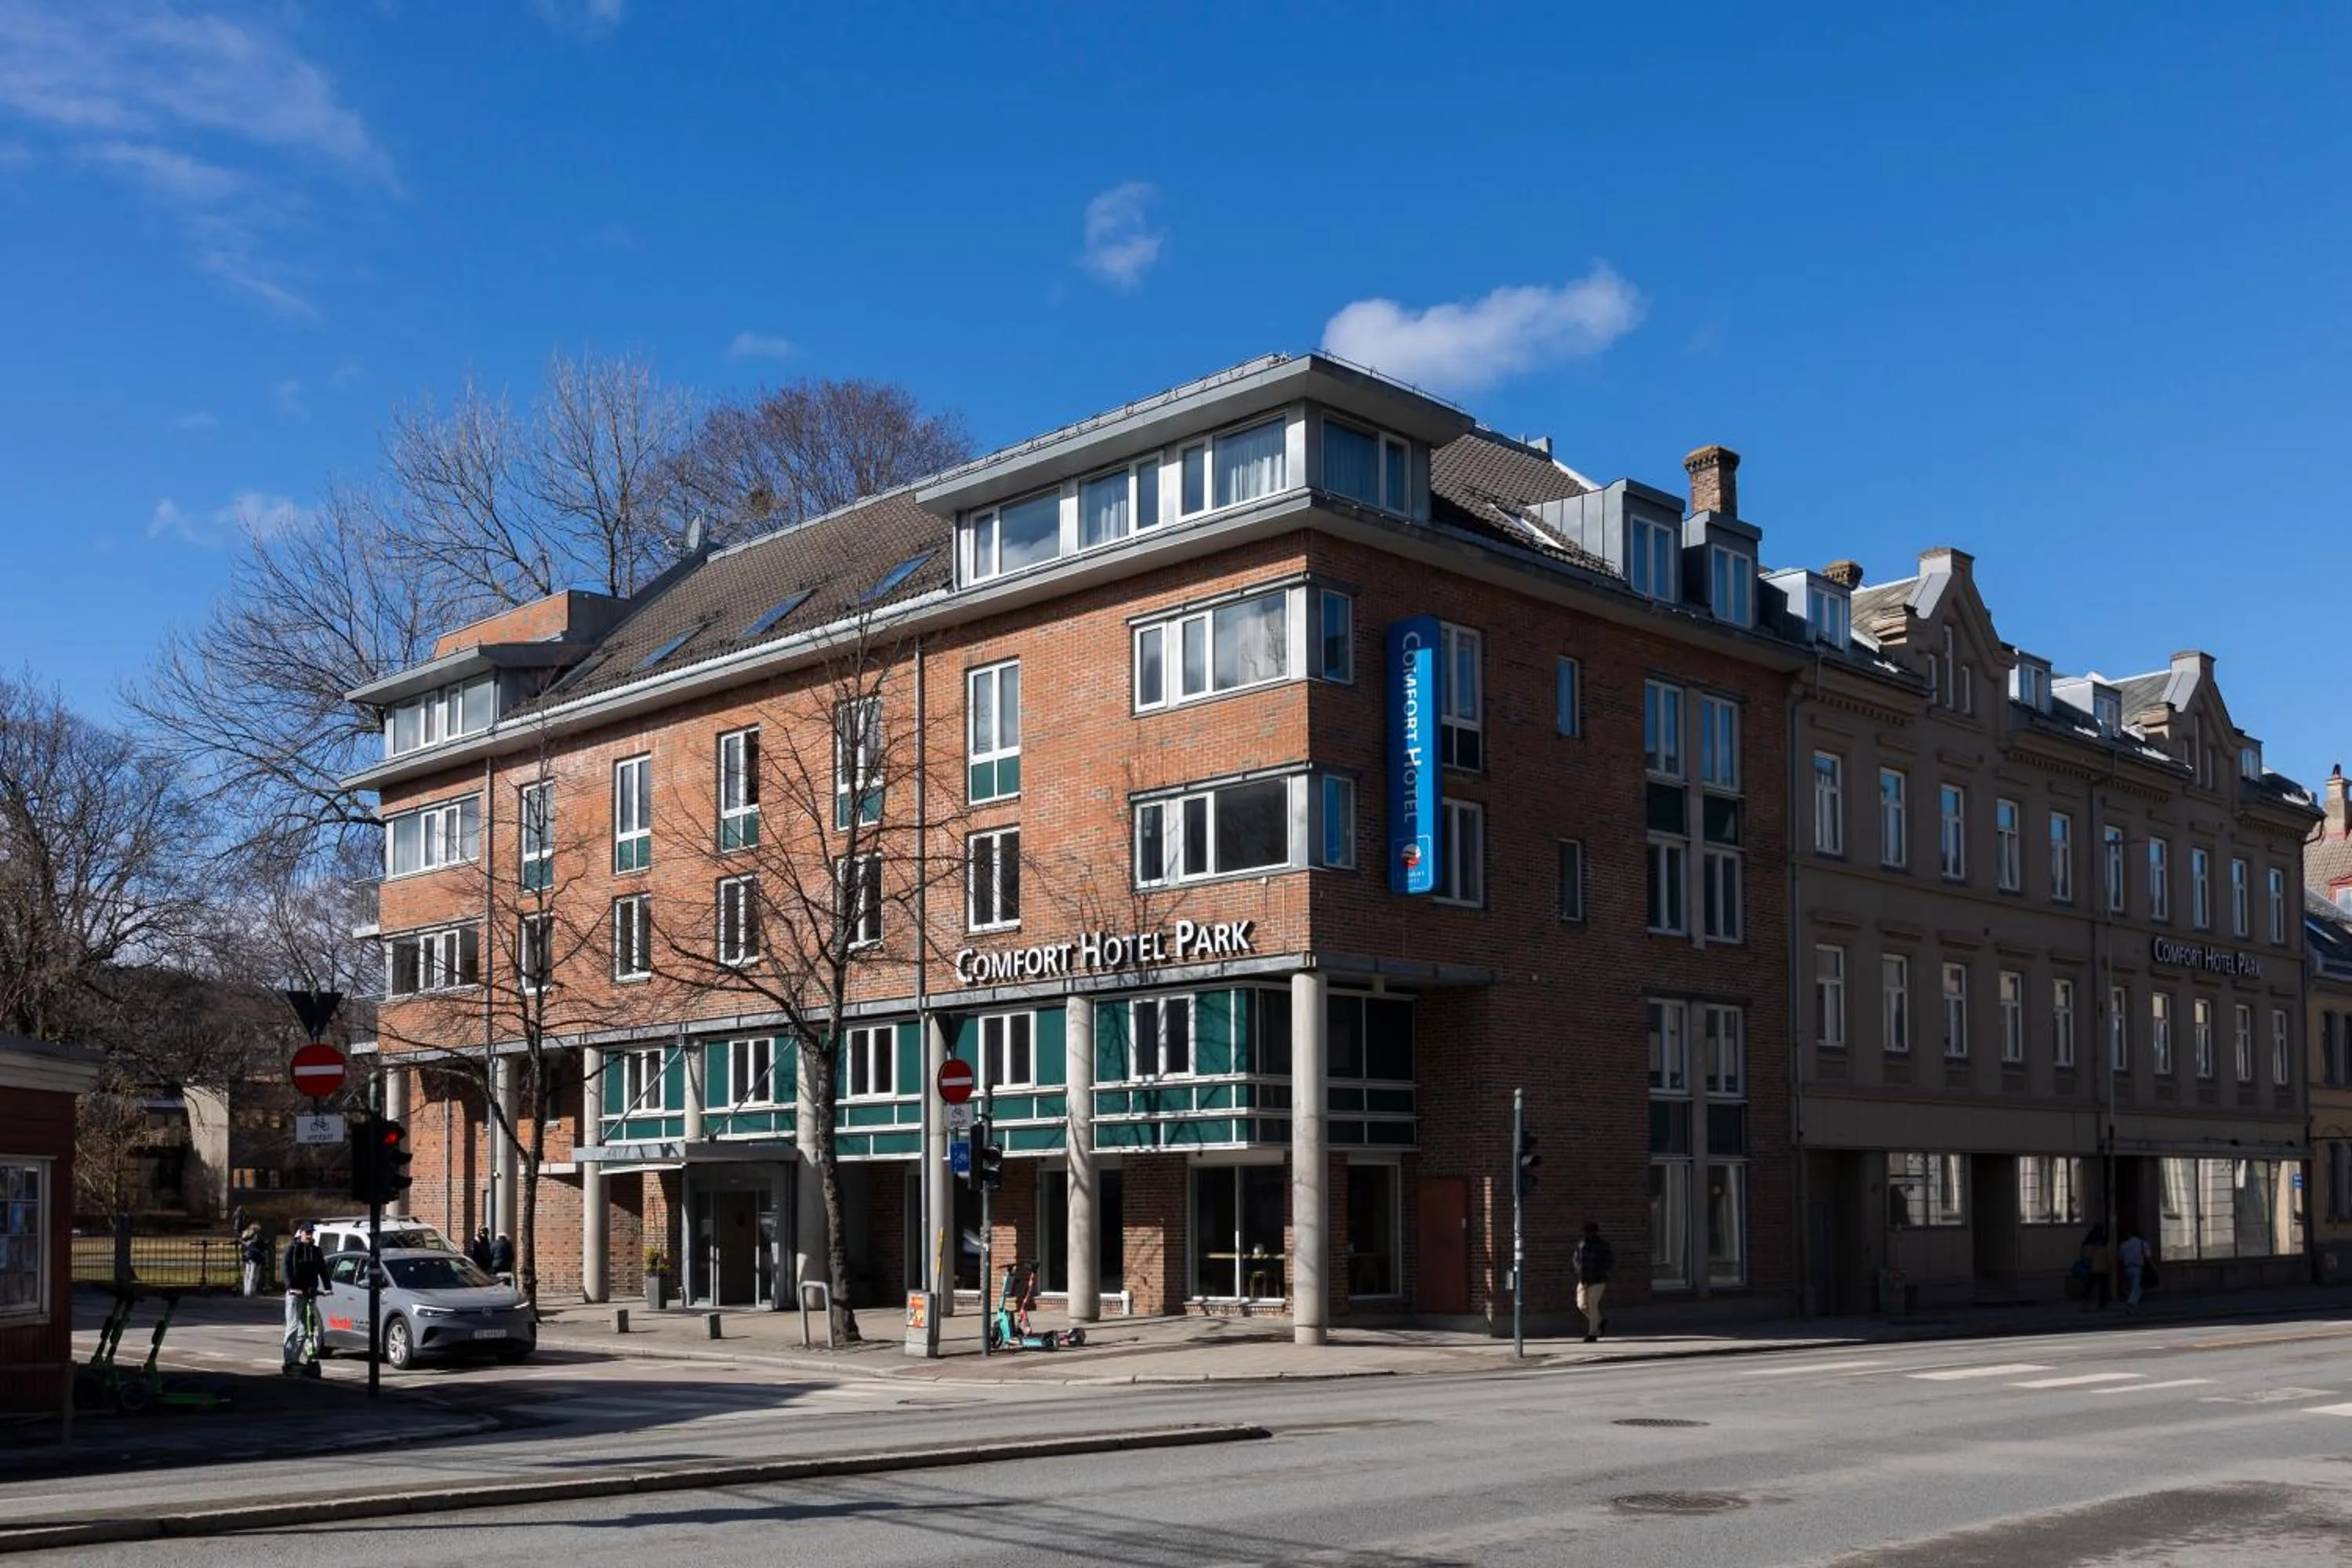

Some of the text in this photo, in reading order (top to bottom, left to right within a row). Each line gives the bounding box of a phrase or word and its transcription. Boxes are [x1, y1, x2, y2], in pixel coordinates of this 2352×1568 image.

[1403, 631, 1422, 823] COMFORT HOTEL
[956, 920, 1250, 983] COMFORT HOTEL PARK
[2154, 937, 2203, 967] COMFORT
[2205, 946, 2237, 975] HOTEL
